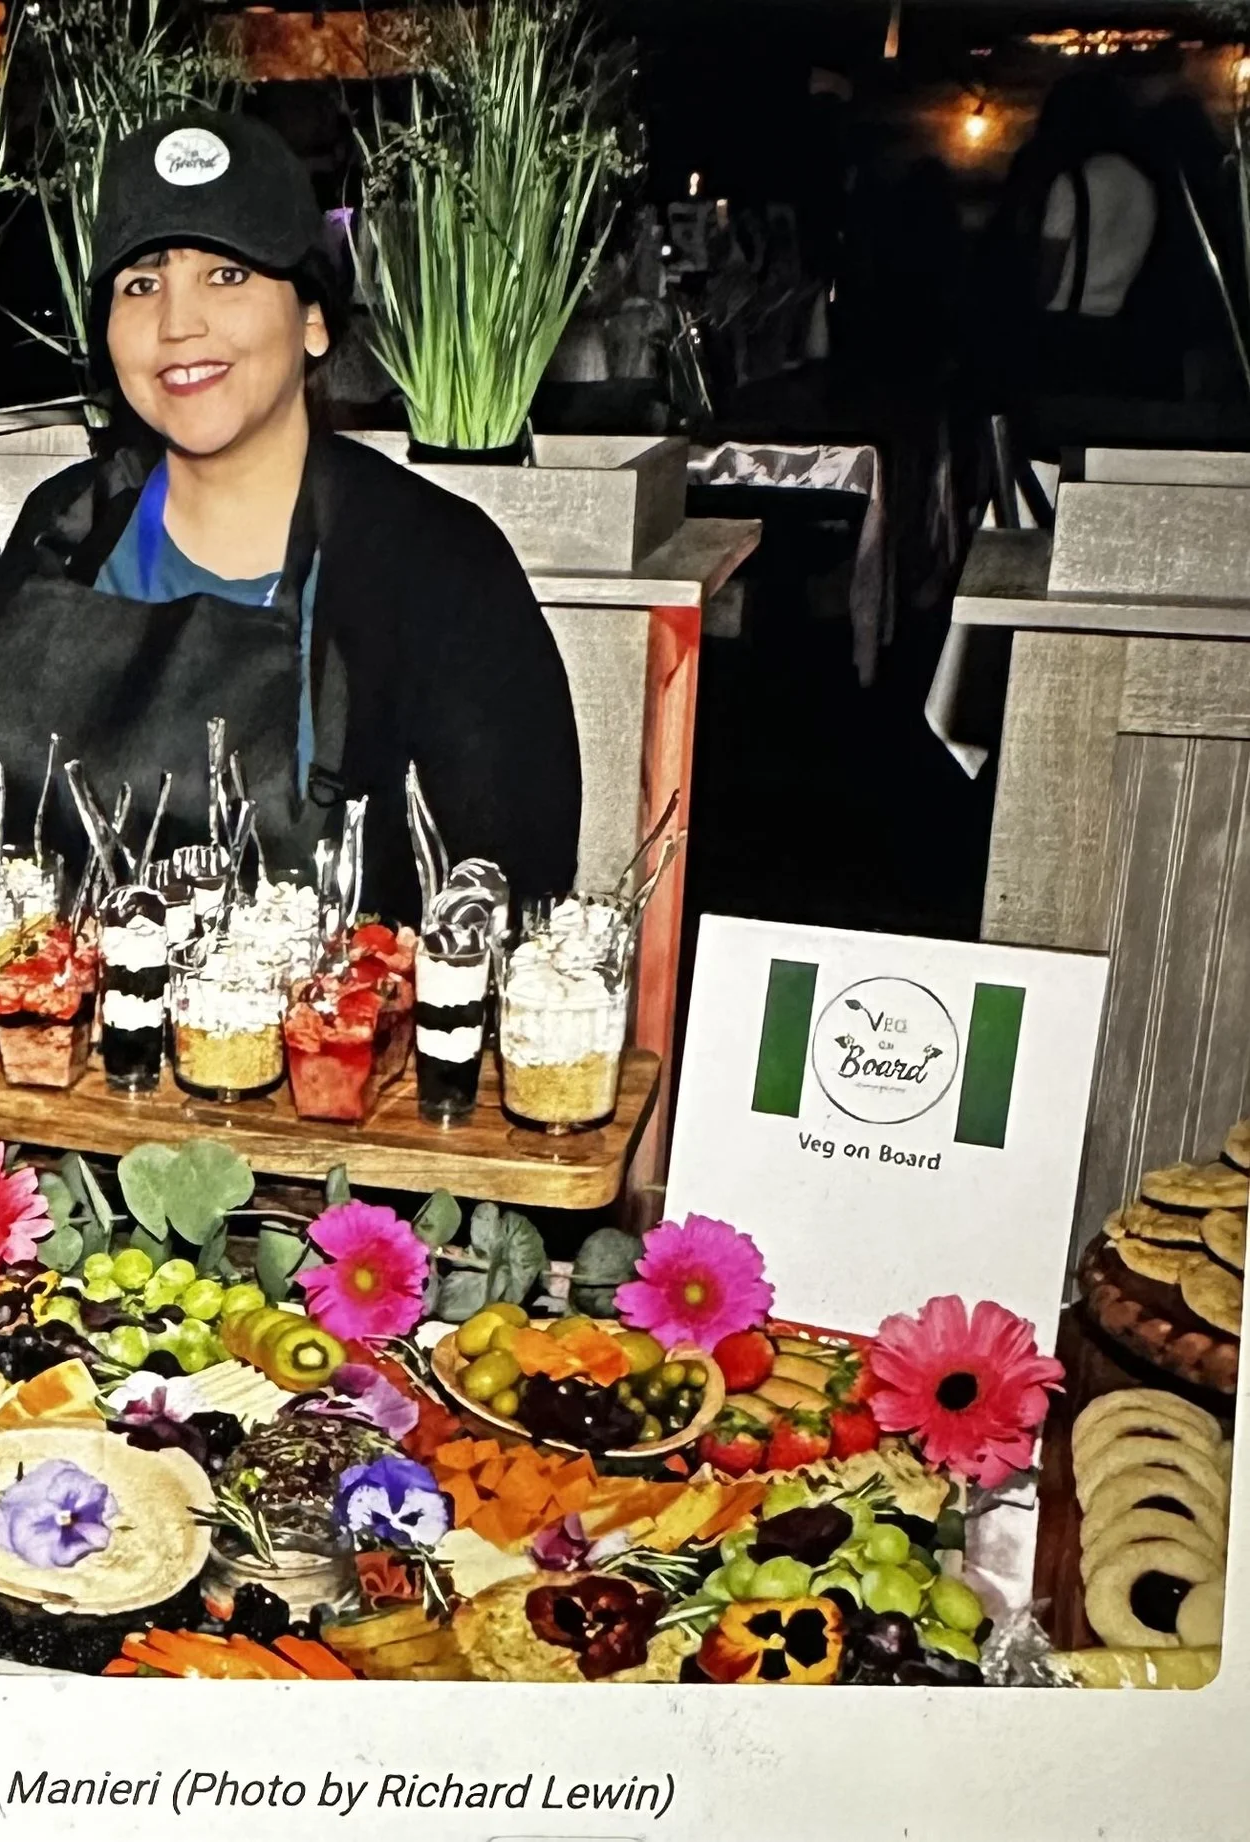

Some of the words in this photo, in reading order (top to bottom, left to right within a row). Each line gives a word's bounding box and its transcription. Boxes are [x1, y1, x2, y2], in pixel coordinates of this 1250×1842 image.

[837, 1044, 929, 1085] Board
[798, 1131, 836, 1159] Veg
[842, 1143, 871, 1160] on
[878, 1143, 942, 1171] Board
